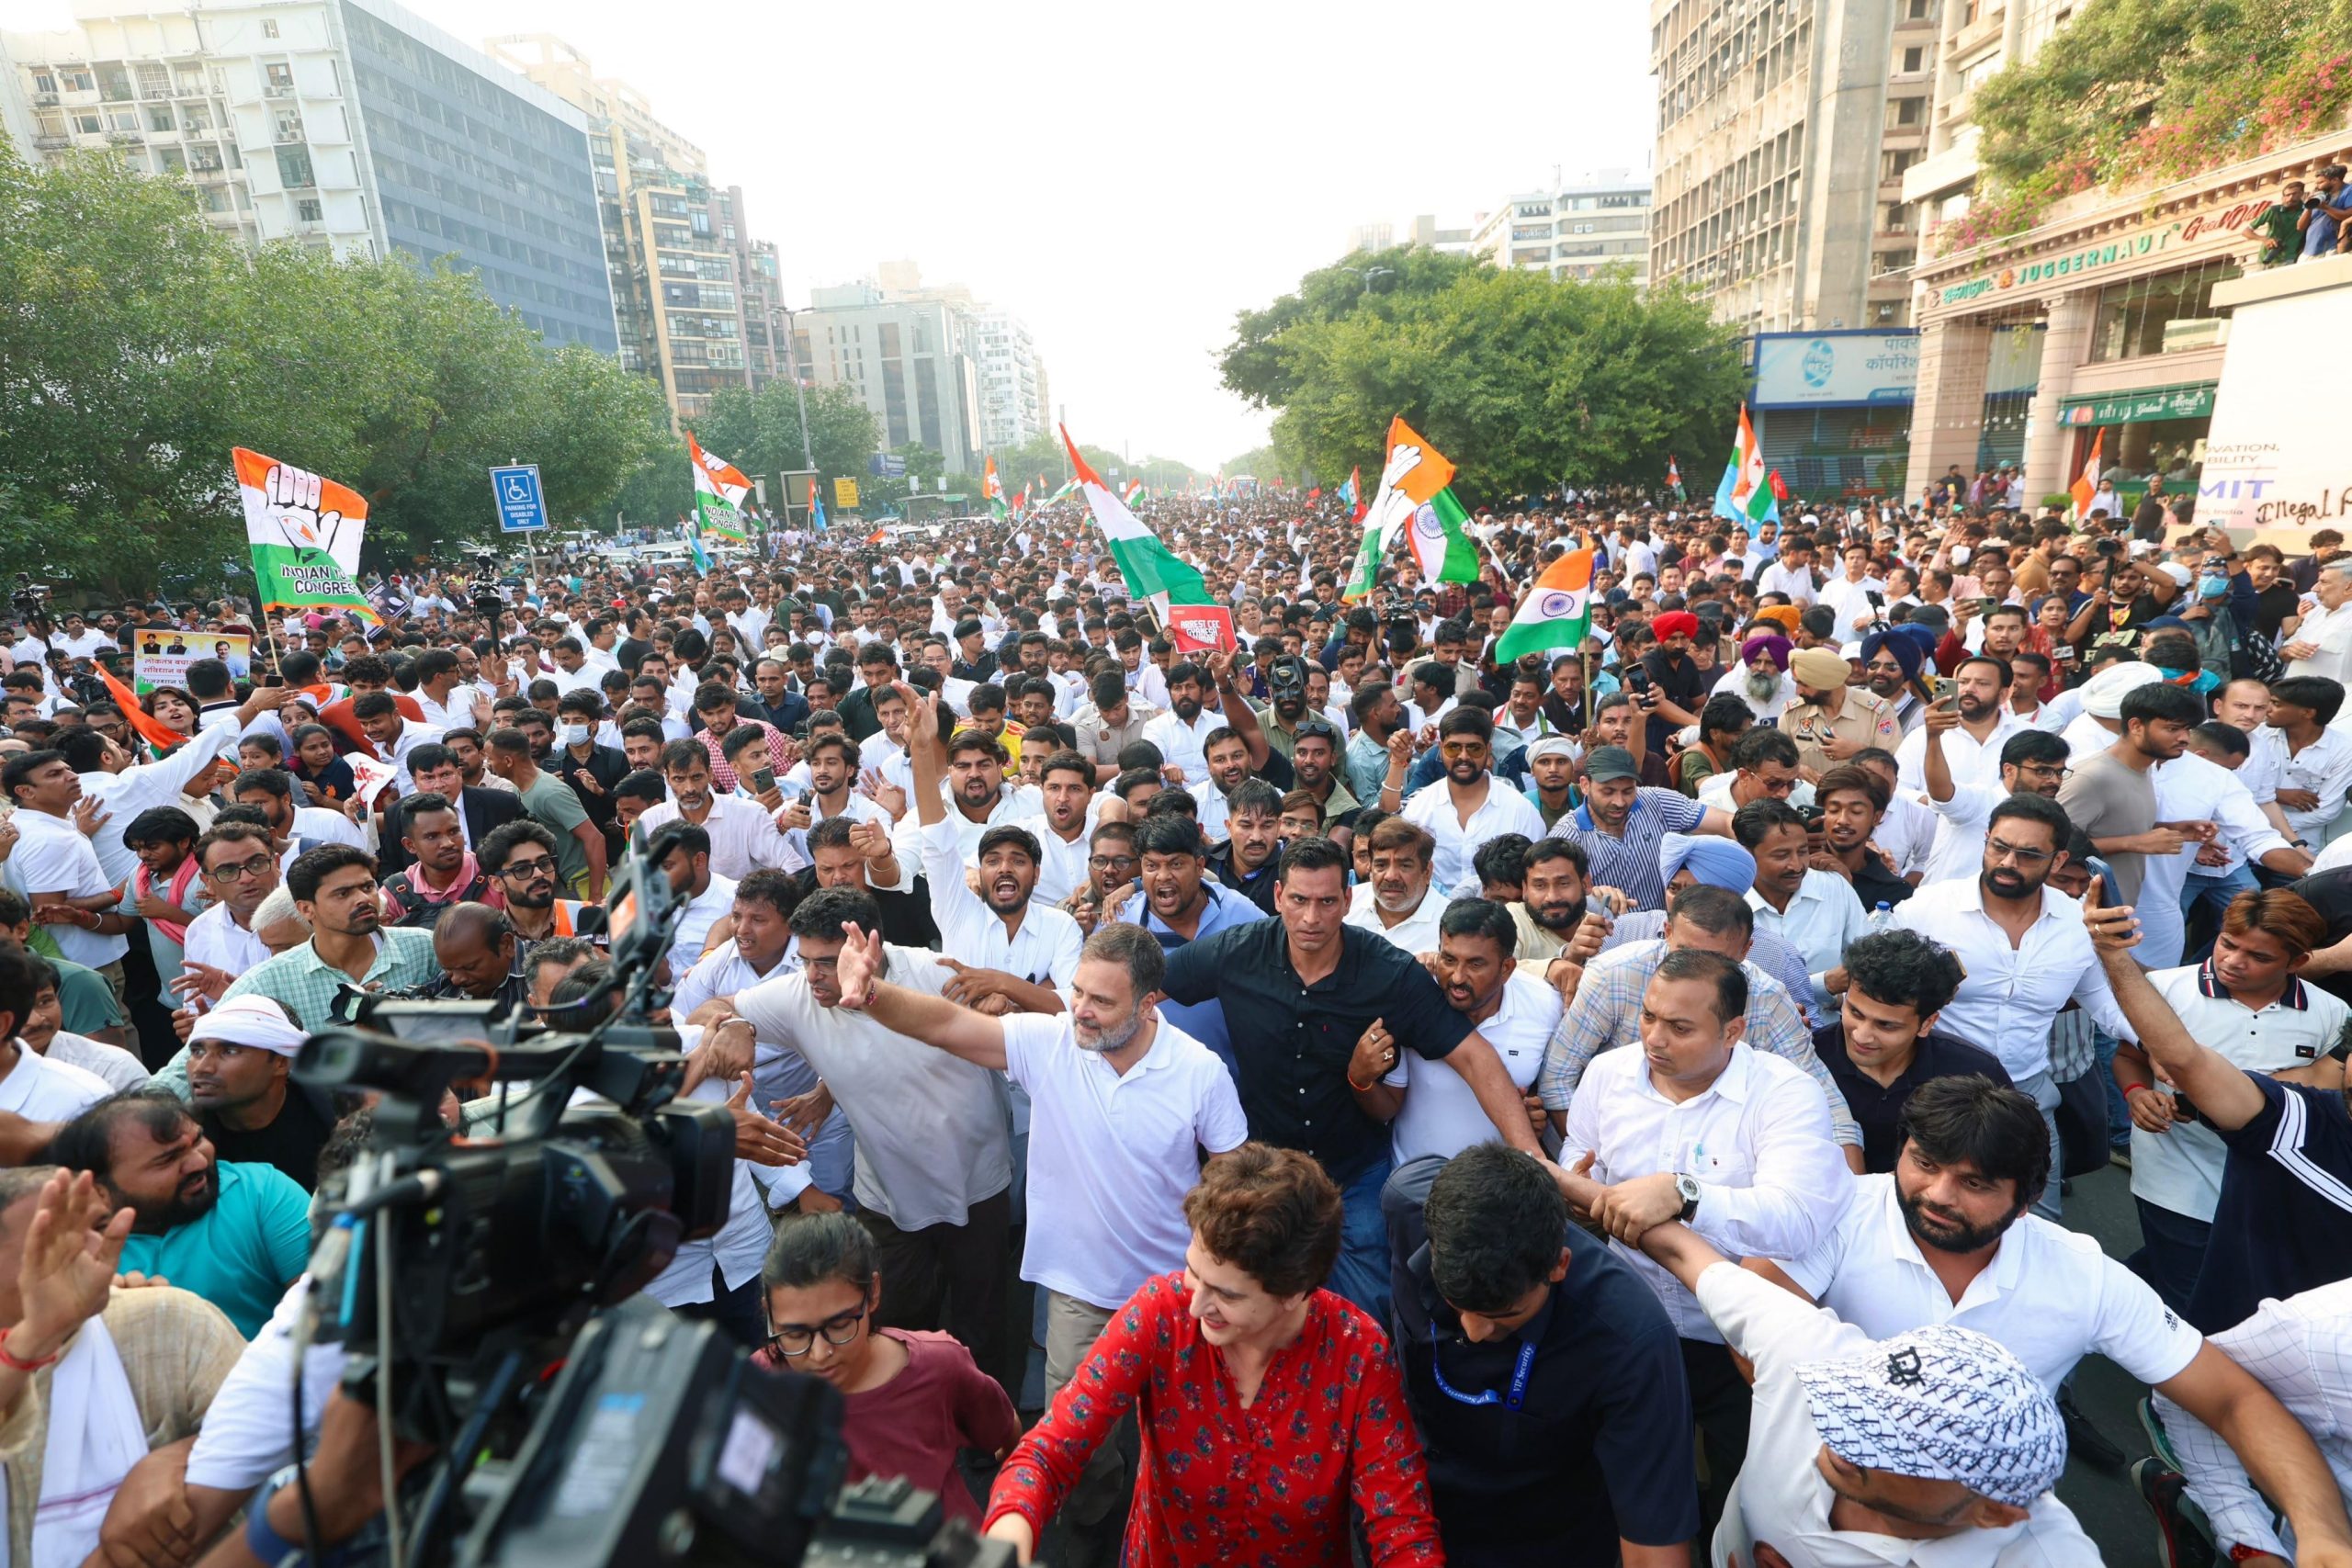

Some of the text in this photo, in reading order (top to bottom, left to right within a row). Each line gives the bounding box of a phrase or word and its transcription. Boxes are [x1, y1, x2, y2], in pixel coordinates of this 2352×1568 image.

[2018, 230, 2170, 285] JUGGERNAUT
[281, 564, 330, 580] INDIAN
[1513, 1344, 1534, 1393] VIP Security
